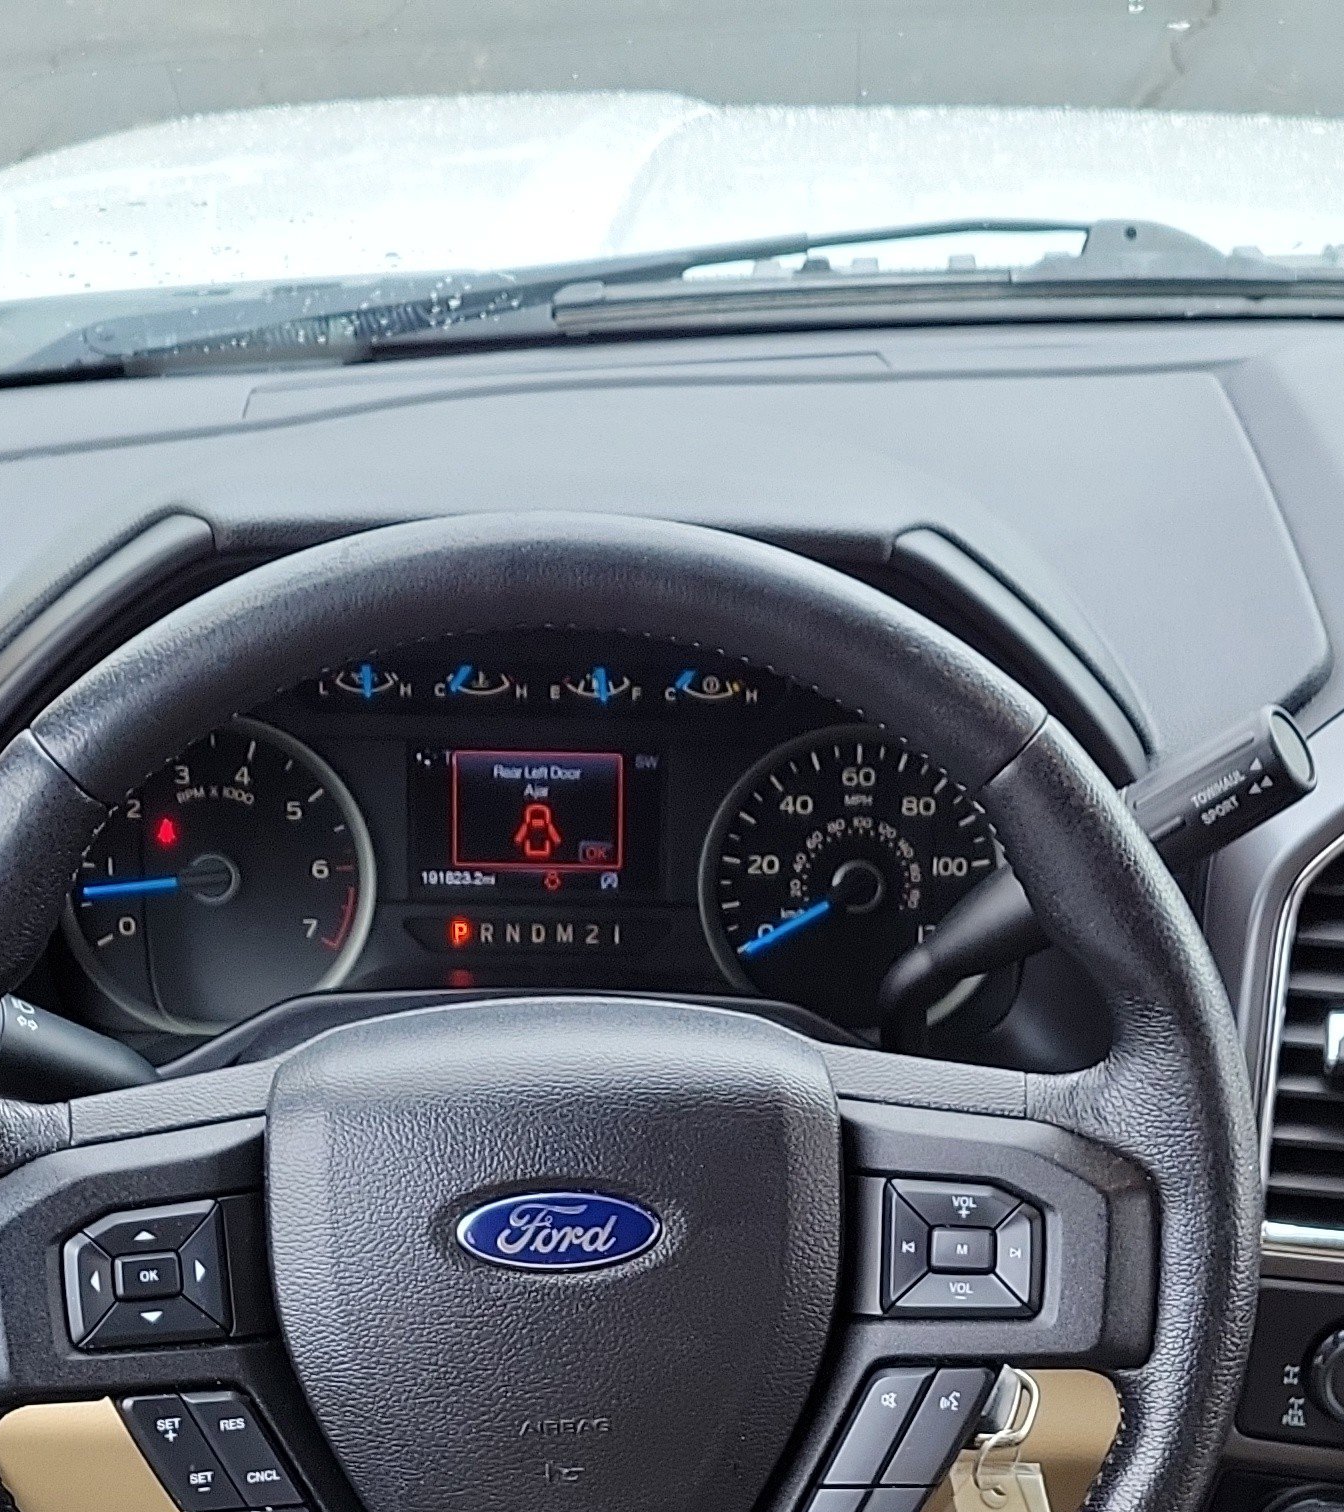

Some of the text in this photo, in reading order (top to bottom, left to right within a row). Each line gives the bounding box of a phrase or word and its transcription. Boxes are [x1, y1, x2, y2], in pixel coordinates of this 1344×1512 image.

[318, 681, 329, 694] L
[400, 682, 412, 697] H
[515, 684, 527, 699] H
[665, 686, 676, 701] C
[746, 688, 758, 702] H
[175, 765, 190, 784] 3
[234, 766, 251, 786] 4
[842, 768, 875, 788] 60
[222, 785, 255, 805] 1000
[126, 800, 141, 818] 2
[286, 803, 302, 820] 5
[779, 794, 814, 815] 40
[901, 796, 936, 817] 80
[1201, 795, 1239, 825] SPORT
[311, 860, 329, 877] 6
[747, 855, 780, 875] 20
[932, 856, 968, 877] 100
[118, 916, 136, 936] 0
[302, 918, 319, 937] 7
[454, 922, 469, 944] P
[479, 923, 494, 943] R
[506, 924, 521, 943] N
[531, 924, 546, 943] D
[556, 924, 574, 943] M
[584, 925, 600, 945] 2
[952, 1196, 977, 1208] VOL
[496, 1203, 619, 1254] Ford
[956, 1244, 968, 1255] M
[139, 1269, 160, 1282] OK
[950, 1283, 974, 1294] VOL
[156, 1417, 181, 1431] SET
[219, 1417, 245, 1431] RES
[519, 1417, 613, 1437] AIRBAG
[189, 1471, 214, 1484] SET
[246, 1468, 281, 1483] CNCL
